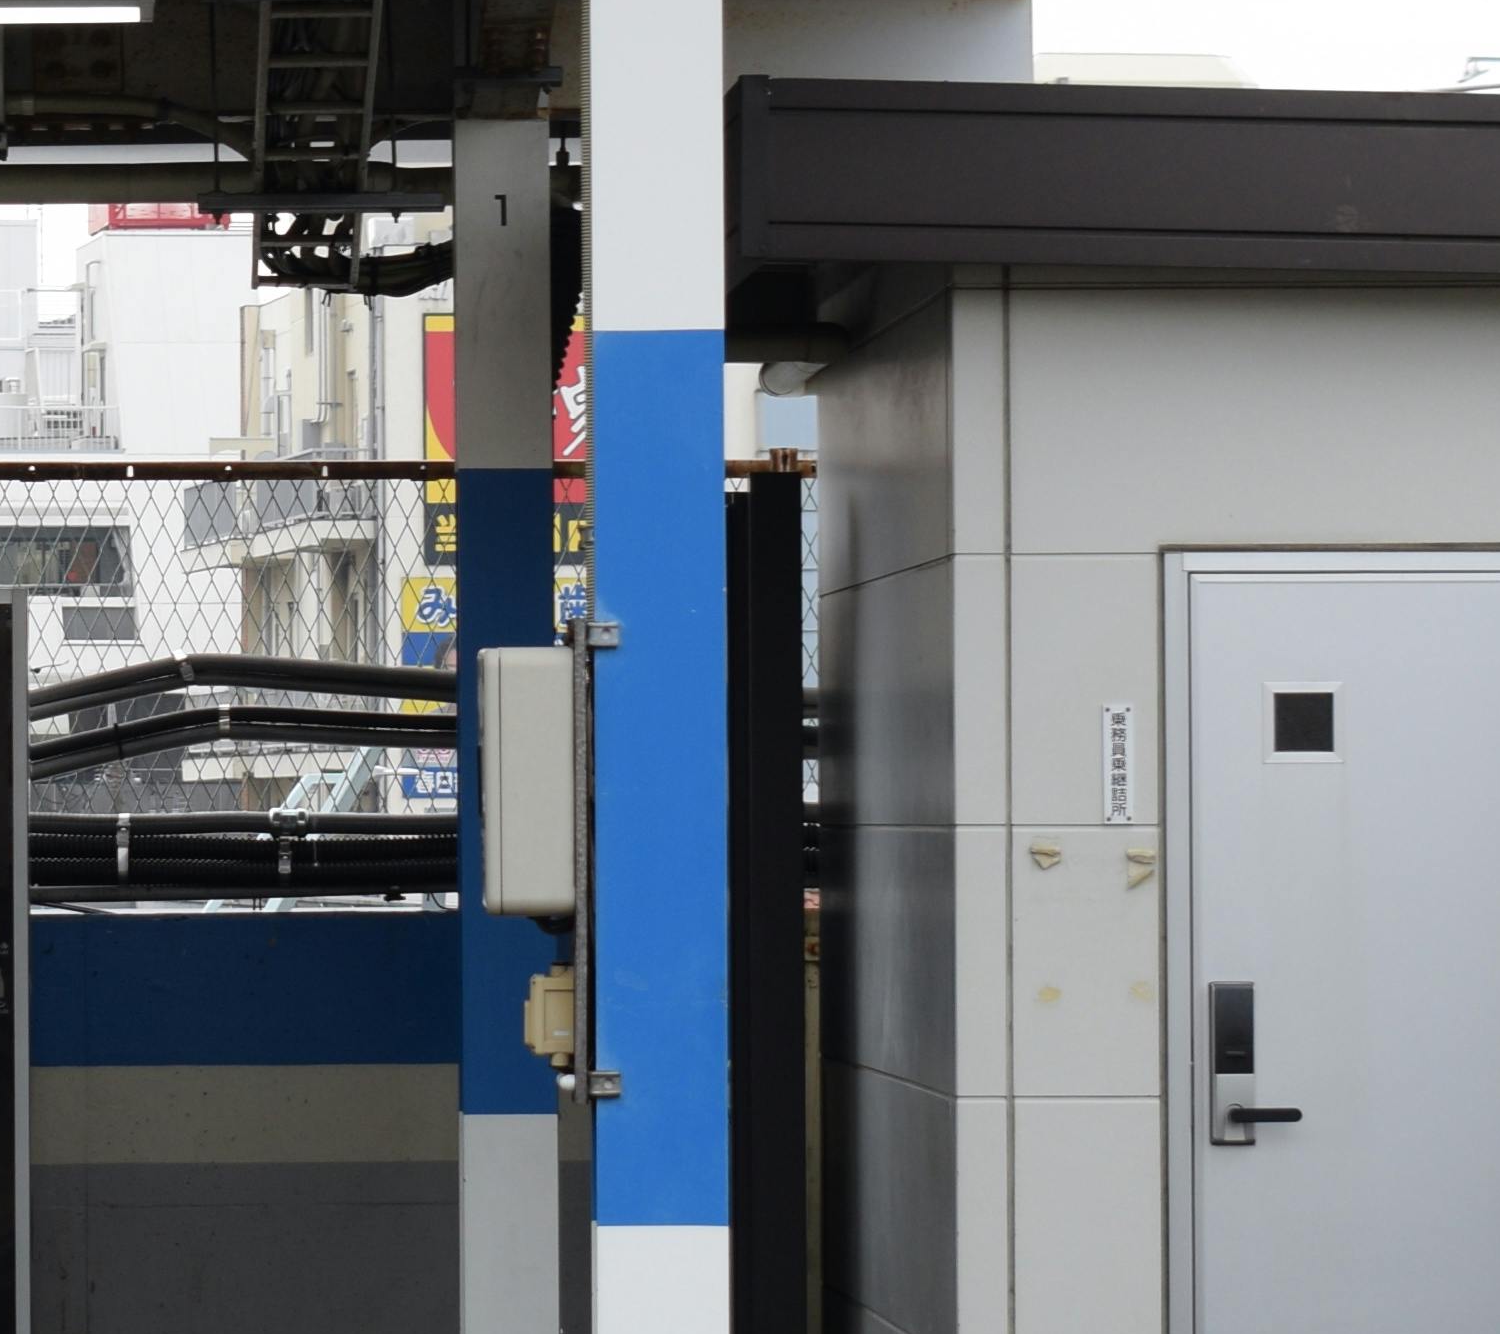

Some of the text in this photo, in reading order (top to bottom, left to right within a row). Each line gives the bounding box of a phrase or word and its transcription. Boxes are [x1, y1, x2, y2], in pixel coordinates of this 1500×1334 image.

[494, 194, 508, 227] 1
[1111, 712, 1127, 816] 乗務員乗継詰所
